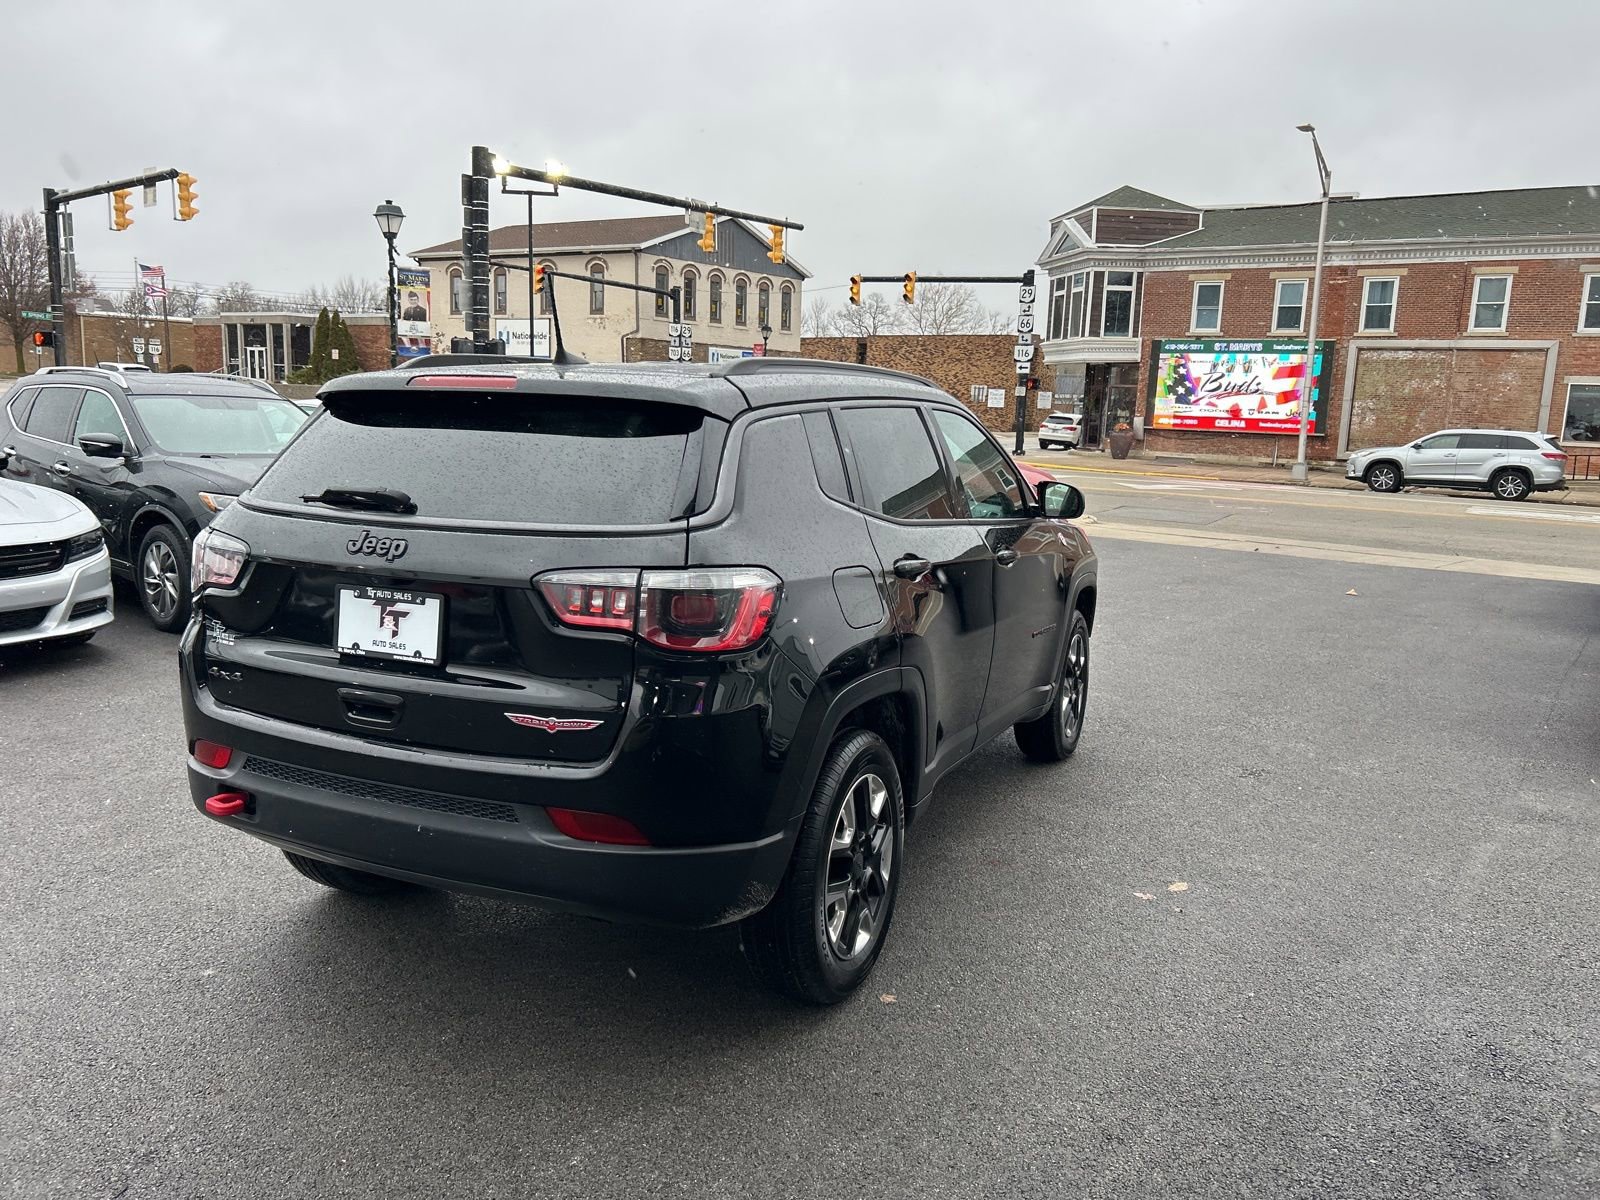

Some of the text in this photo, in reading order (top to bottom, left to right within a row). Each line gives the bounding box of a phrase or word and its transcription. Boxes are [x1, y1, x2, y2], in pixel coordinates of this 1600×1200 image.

[1022, 288, 1033, 299] 29
[1020, 318, 1031, 329] 66
[683, 327, 691, 335] 29
[683, 350, 691, 358] 66
[1017, 349, 1030, 358] 116
[347, 529, 409, 563] Jeep
[377, 590, 392, 600] AUTO
[393, 592, 412, 601] SALES
[372, 640, 407, 651] AUTO SALES
[208, 666, 243, 681] 4x4
